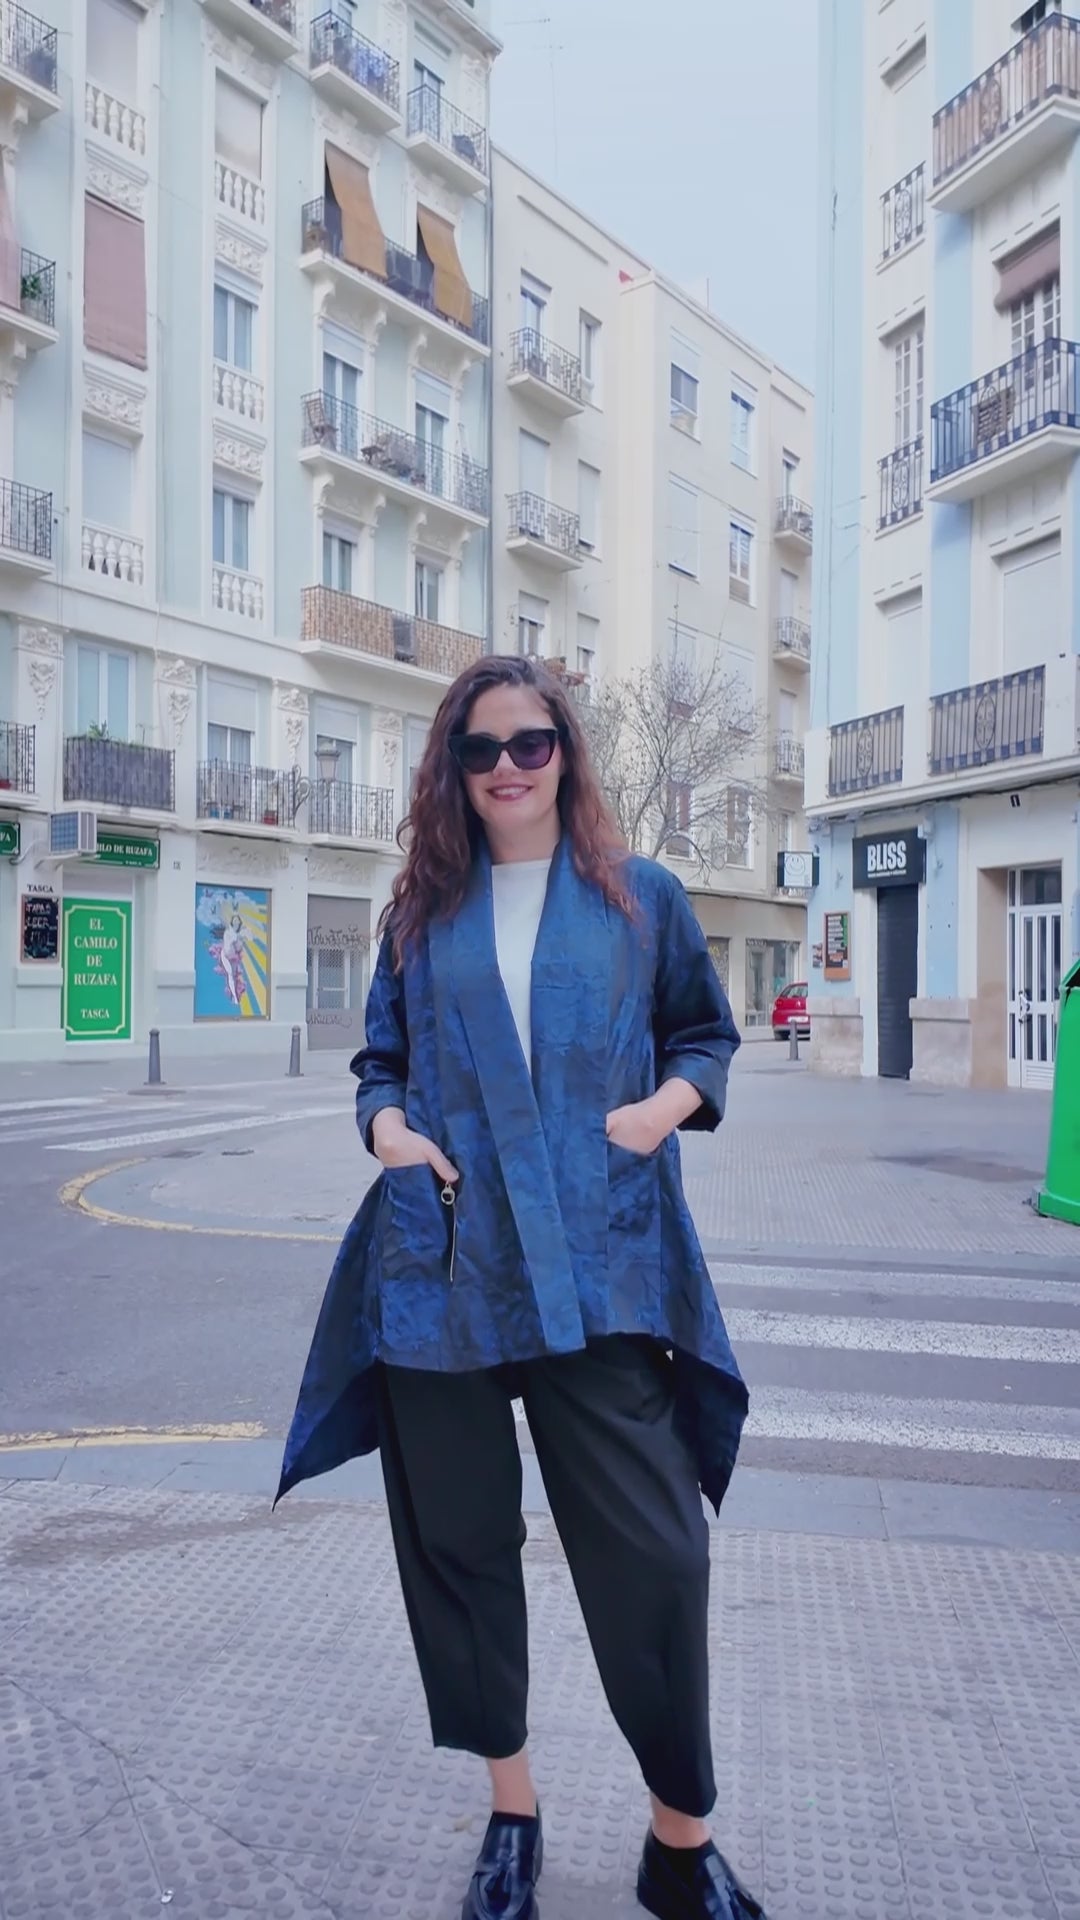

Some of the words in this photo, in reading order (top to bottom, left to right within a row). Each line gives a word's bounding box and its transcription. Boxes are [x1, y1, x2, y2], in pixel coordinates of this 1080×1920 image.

[113, 844, 124, 854] DE
[125, 845, 153, 857] RUZAFA
[867, 840, 907, 872] BLISS
[27, 884, 54, 893] TASCA
[89, 918, 104, 930] EL
[74, 936, 118, 949] CAMILO
[86, 954, 103, 967] DE
[74, 973, 117, 986] RUZAFA
[81, 1009, 110, 1019] TASCA
